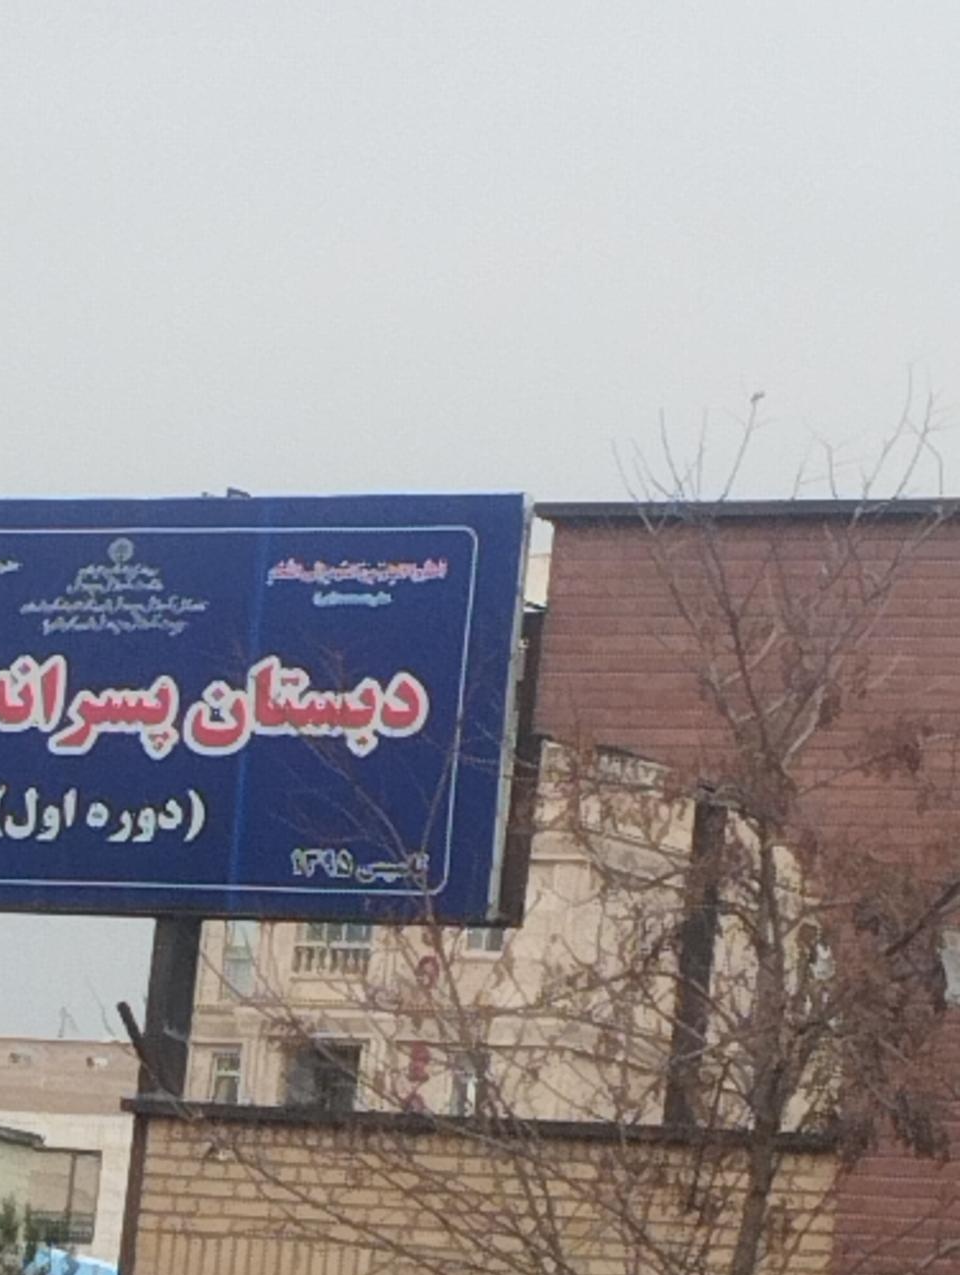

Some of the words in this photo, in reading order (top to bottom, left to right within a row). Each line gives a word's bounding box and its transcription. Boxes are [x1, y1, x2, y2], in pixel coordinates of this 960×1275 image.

[183, 655, 430, 758] دبستان
[86, 789, 205, 842] (دوره
[291, 848, 353, 878] ۱۳۹۵
